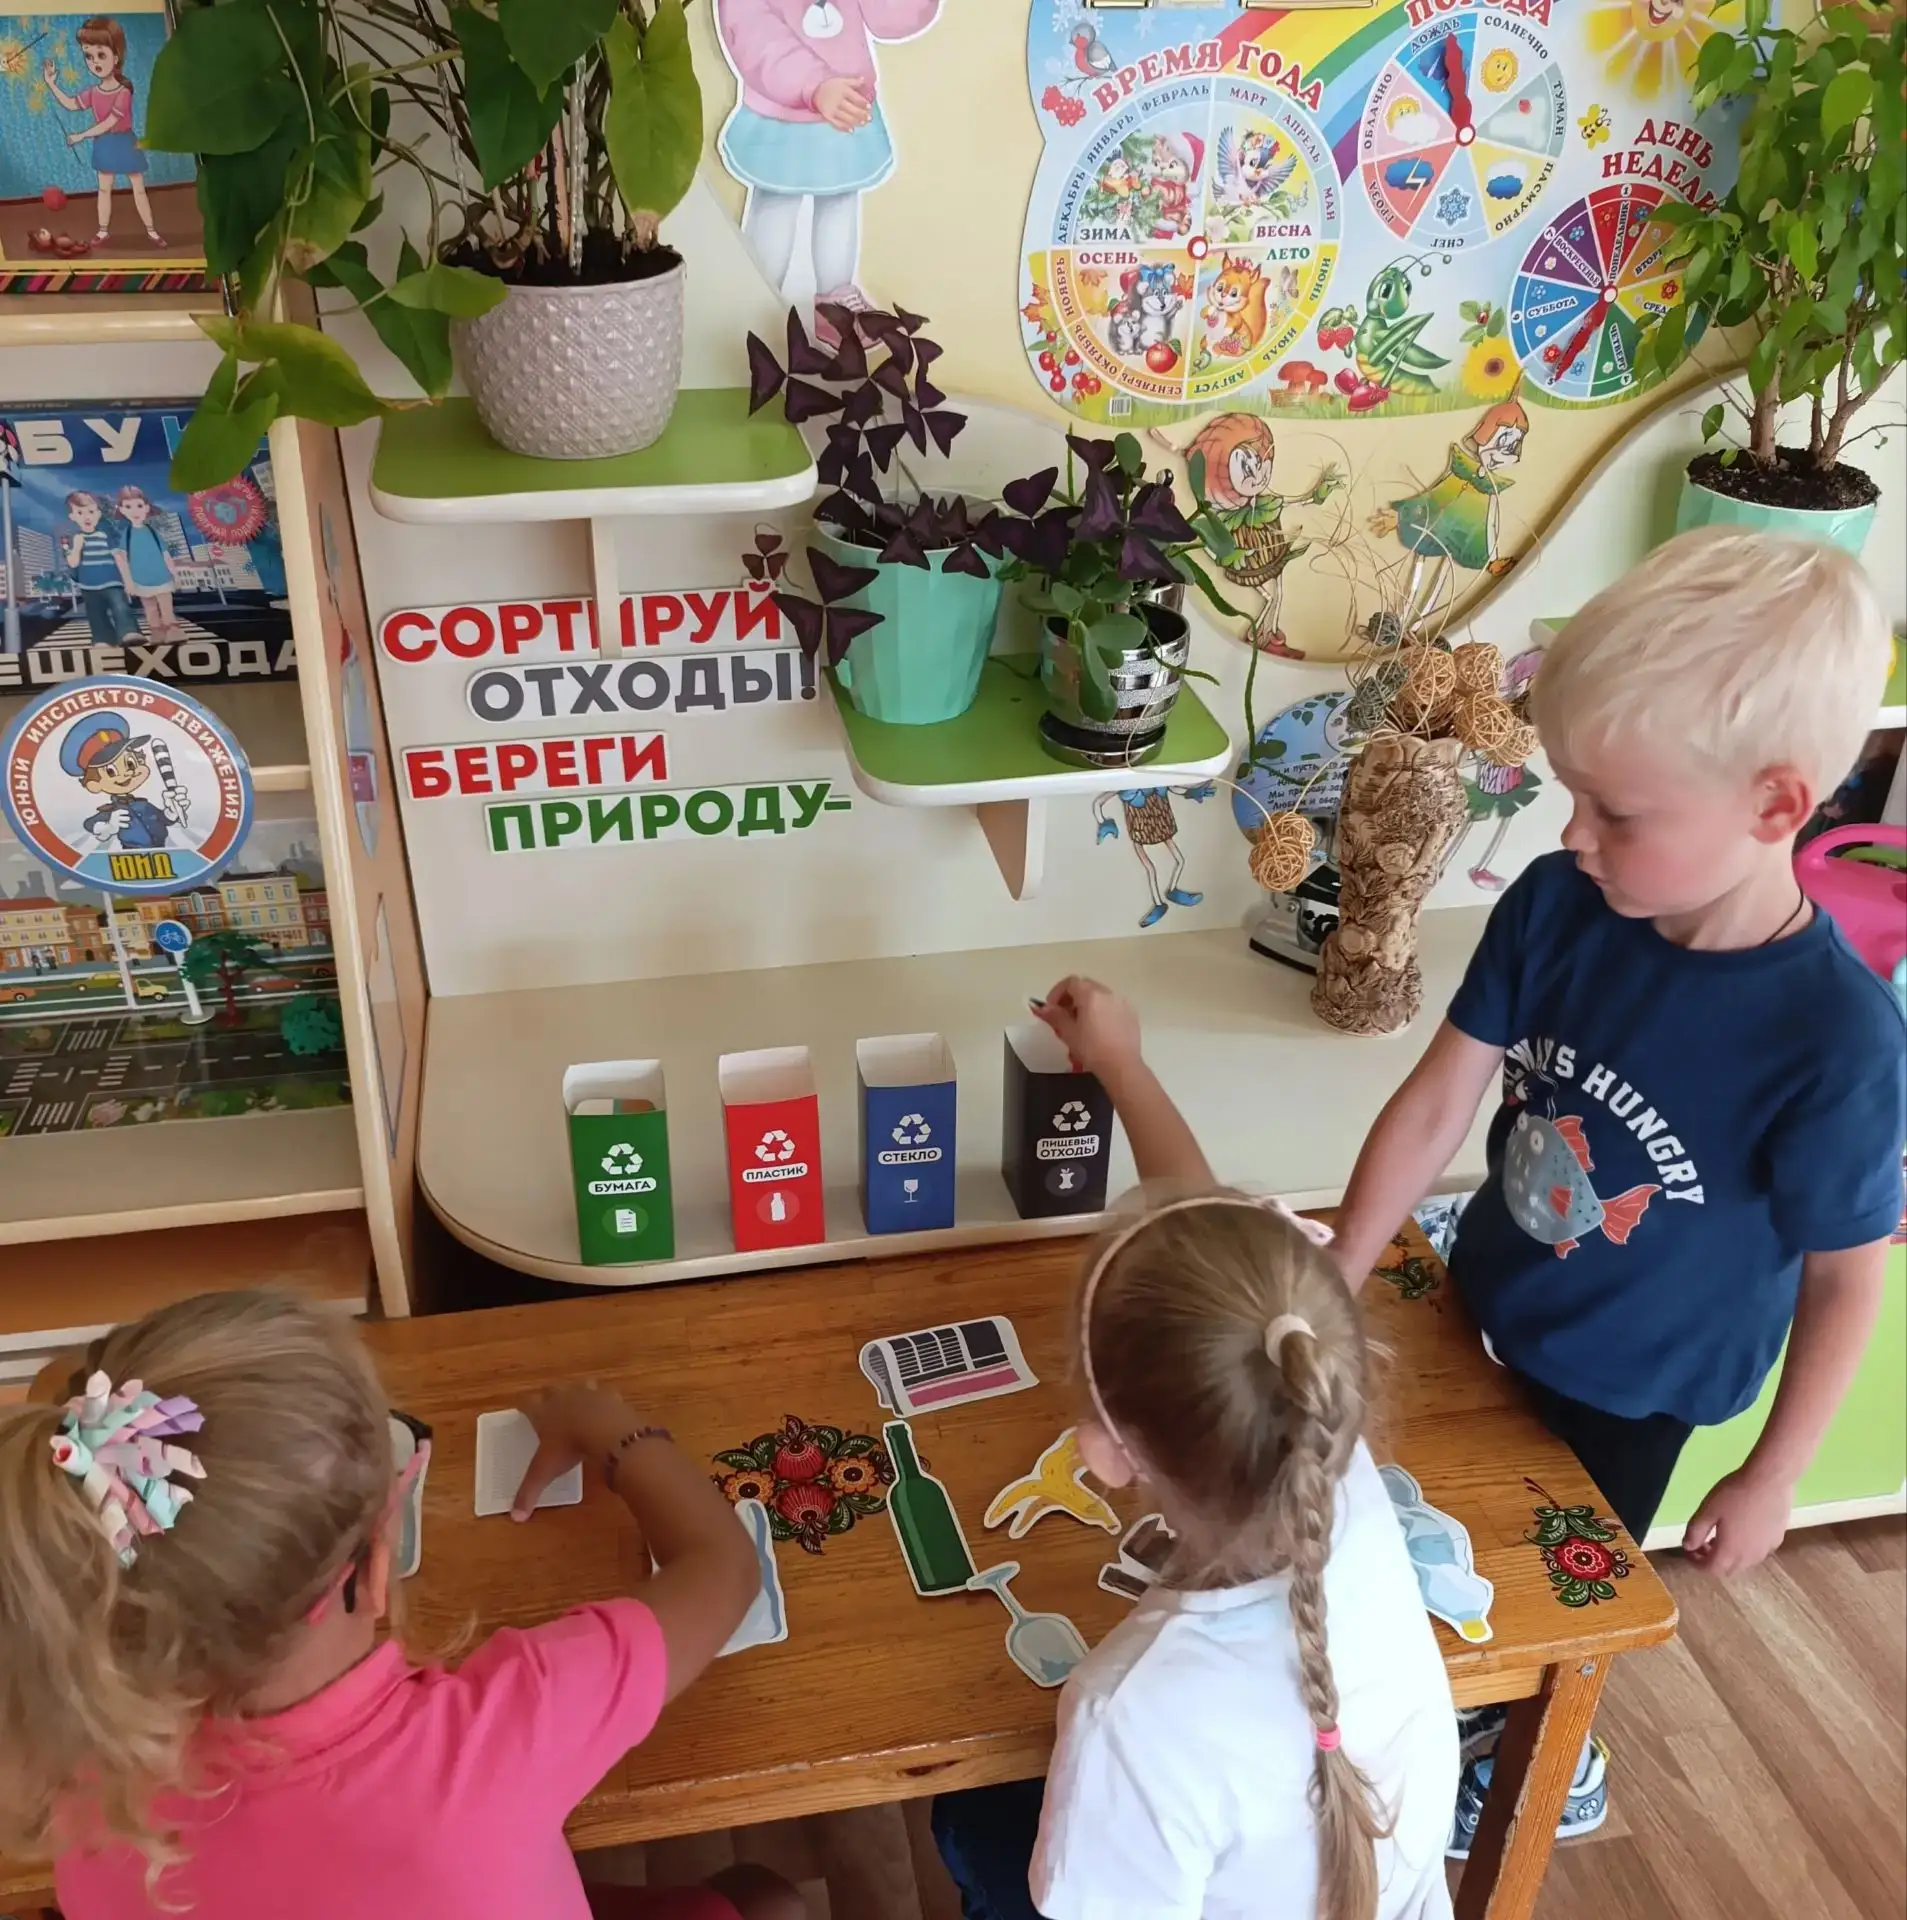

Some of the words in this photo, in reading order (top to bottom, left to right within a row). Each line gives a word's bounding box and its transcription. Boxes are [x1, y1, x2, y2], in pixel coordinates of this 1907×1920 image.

[1412, 19, 1460, 53] ДОЖДЬ
[1484, 16, 1548, 59] СОЛНЕЧНО
[1093, 42, 1219, 112] ВРЕМЯ
[1238, 45, 1323, 110] ГОДА
[1230, 87, 1267, 106] МАРТ
[1142, 85, 1209, 112] ФЕВРАЛЬ
[1364, 74, 1392, 149] ОБЛАЧНО
[1553, 81, 1563, 136] ТУМАН
[1087, 114, 1134, 164] ЯНВАРЬ
[1283, 114, 1320, 163] АПРЕЛЬ
[1634, 119, 1713, 168] ДЕНЬ
[1058, 171, 1085, 244] ДЕКАБРЬ
[1368, 181, 1397, 223] ГРОЗА
[1495, 162, 1553, 231] ПАСМУРНО
[1080, 228, 1131, 240] ЗИМА
[1256, 225, 1311, 238] ВЕСНА
[1431, 238, 1464, 248] СНЕГ
[1610, 202, 1628, 279] ПОНЕДЕЛЬНИК
[1079, 252, 1138, 264] ОСЕНЬ
[1267, 248, 1310, 260] ЛЕТО
[1555, 239, 1600, 286] ВОСКРЕСЕНЬЕ
[1057, 257, 1075, 316] НОЯБРЬ
[1310, 257, 1331, 301] ИЮНЬ
[1528, 299, 1577, 318] СУББОТА
[1075, 325, 1118, 375] ОКТЯБРЬ
[1263, 327, 1297, 361] ИЮЛЬ
[1610, 324, 1627, 368] ЧЕТВЕРГ
[1121, 373, 1182, 394] СЕНТЯБРЬ
[1194, 370, 1245, 393] АВГУСТ
[470, 652, 816, 722] ОТХОДЫ!
[15, 758, 39, 826] ЮНЫЙ
[27, 690, 155, 744] ИНСПЕКТОР
[171, 709, 239, 820] ДВИЖЕНИЯ
[406, 735, 667, 799] БЕРЕГИ
[109, 853, 177, 881] ЮИД
[1040, 1146, 1095, 1158] ОТХОДЫ
[1042, 1136, 1096, 1148] ПИЩЕВЫЕ
[1581, 1063, 1705, 1205] HUNGRY
[746, 1165, 804, 1180] ПЛАСТИК
[882, 1149, 938, 1162] СТЕКЛО
[594, 1180, 651, 1193] БУМАГА
